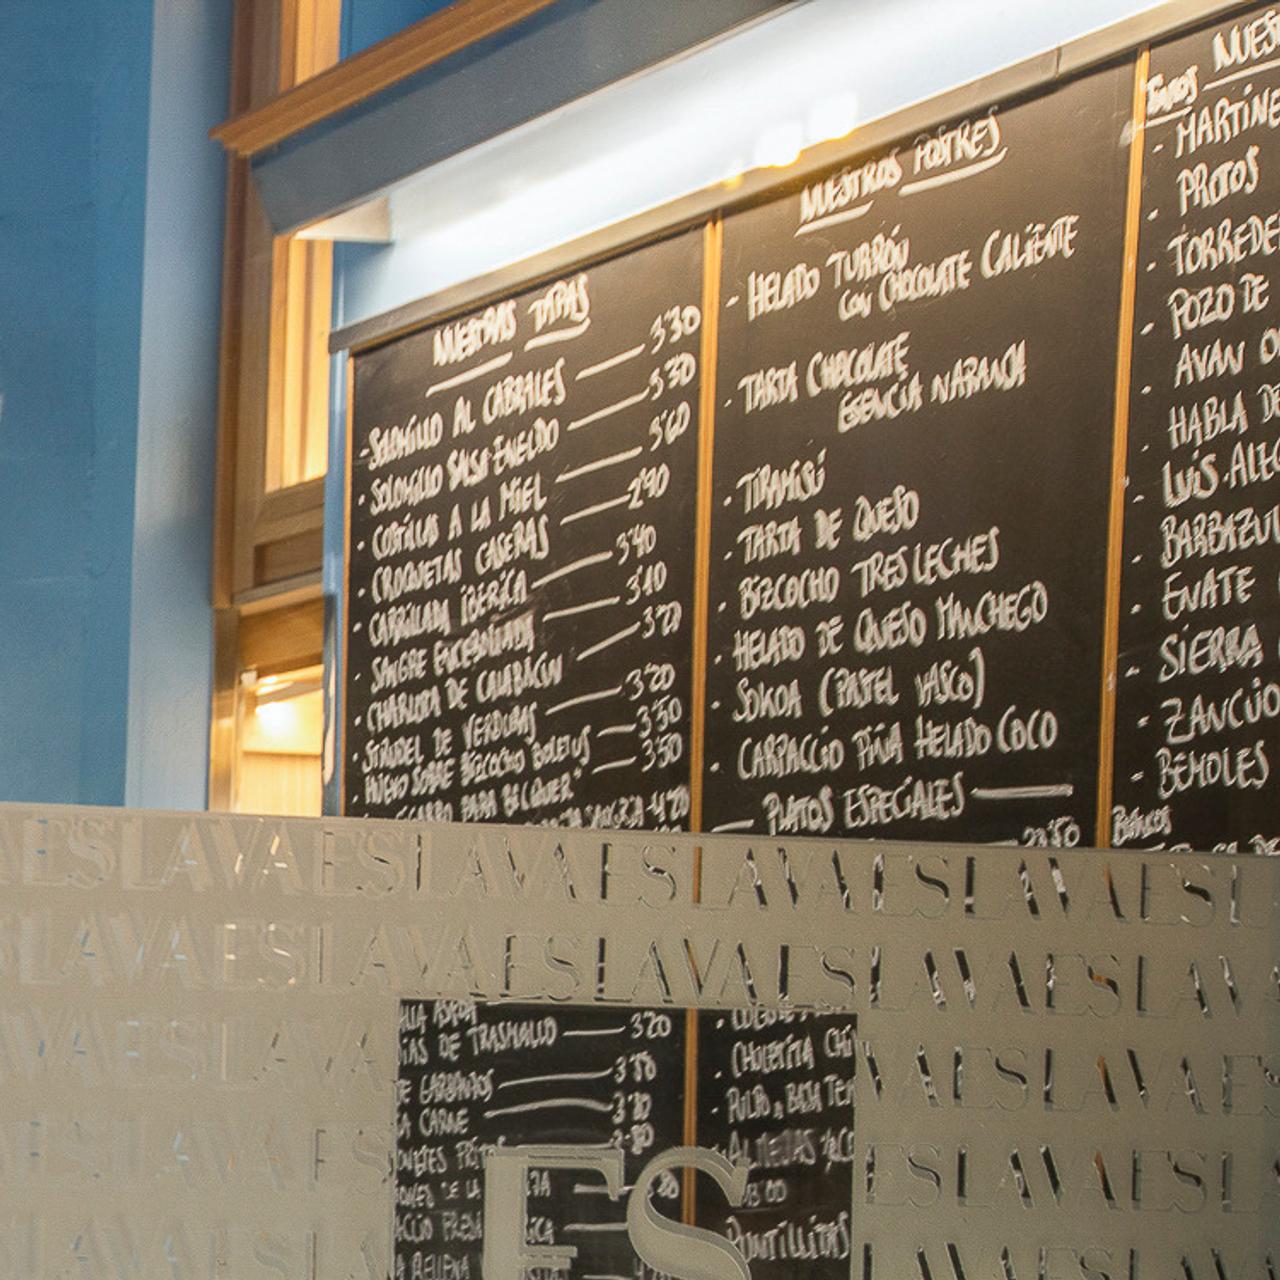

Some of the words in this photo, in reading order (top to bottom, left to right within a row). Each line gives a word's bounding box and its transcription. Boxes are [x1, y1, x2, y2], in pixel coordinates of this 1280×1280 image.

[747, 261, 821, 322] HELADO
[1166, 282, 1237, 341] POZO
[1239, 272, 1272, 315] DE
[737, 360, 800, 416] TARTA
[1173, 337, 1248, 390] AVAN
[1166, 389, 1250, 452] HABLA
[448, 503, 463, 541] A
[470, 496, 492, 534] LA
[737, 516, 803, 565] TARTA
[814, 507, 843, 552] DE
[850, 544, 910, 598] TRES
[912, 525, 1001, 587] LECHES
[1161, 563, 1258, 623] ENATE
[732, 625, 806, 674] HELADO
[853, 600, 928, 656] QUESO
